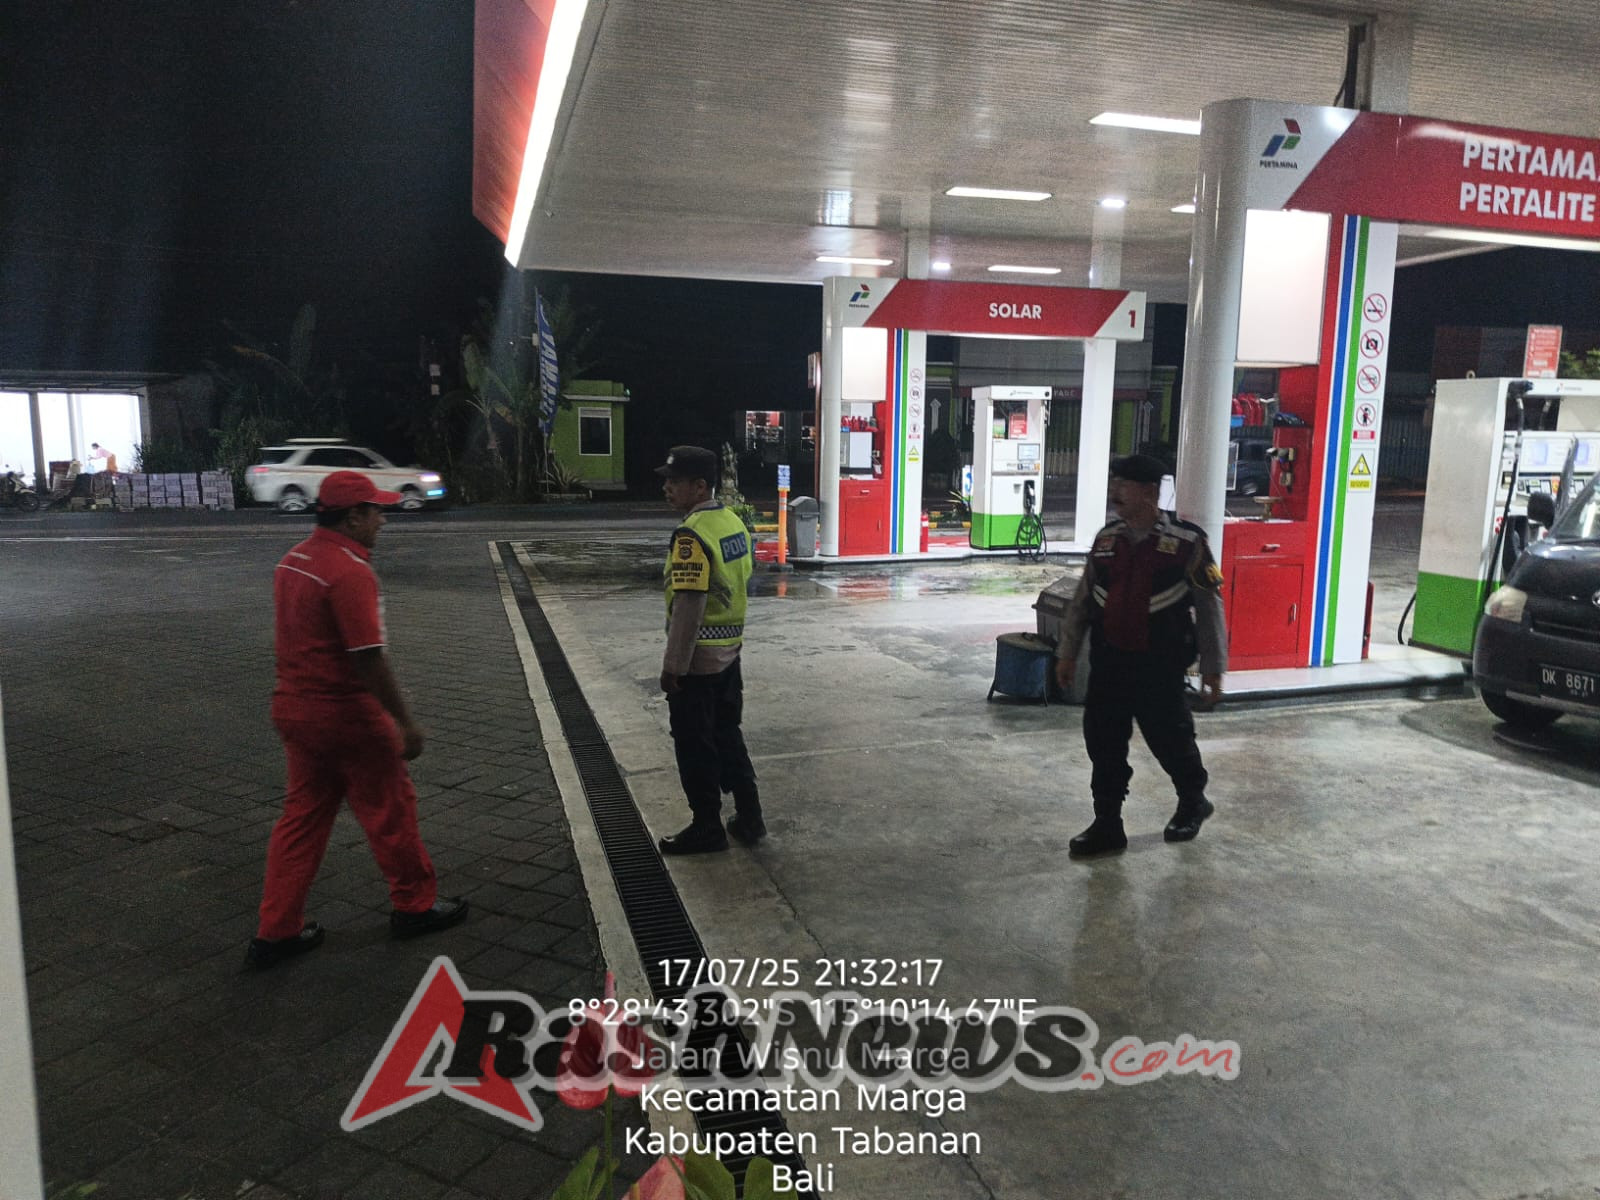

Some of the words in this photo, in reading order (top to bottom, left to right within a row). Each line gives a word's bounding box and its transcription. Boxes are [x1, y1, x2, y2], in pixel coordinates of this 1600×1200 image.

[1463, 135, 1600, 182] PERTAMA
[1459, 181, 1597, 222] PERTALITE
[989, 303, 1042, 319] SOLAR
[1128, 310, 1136, 328] 1
[1542, 668, 1557, 685] DK
[1566, 673, 1594, 693] 8671
